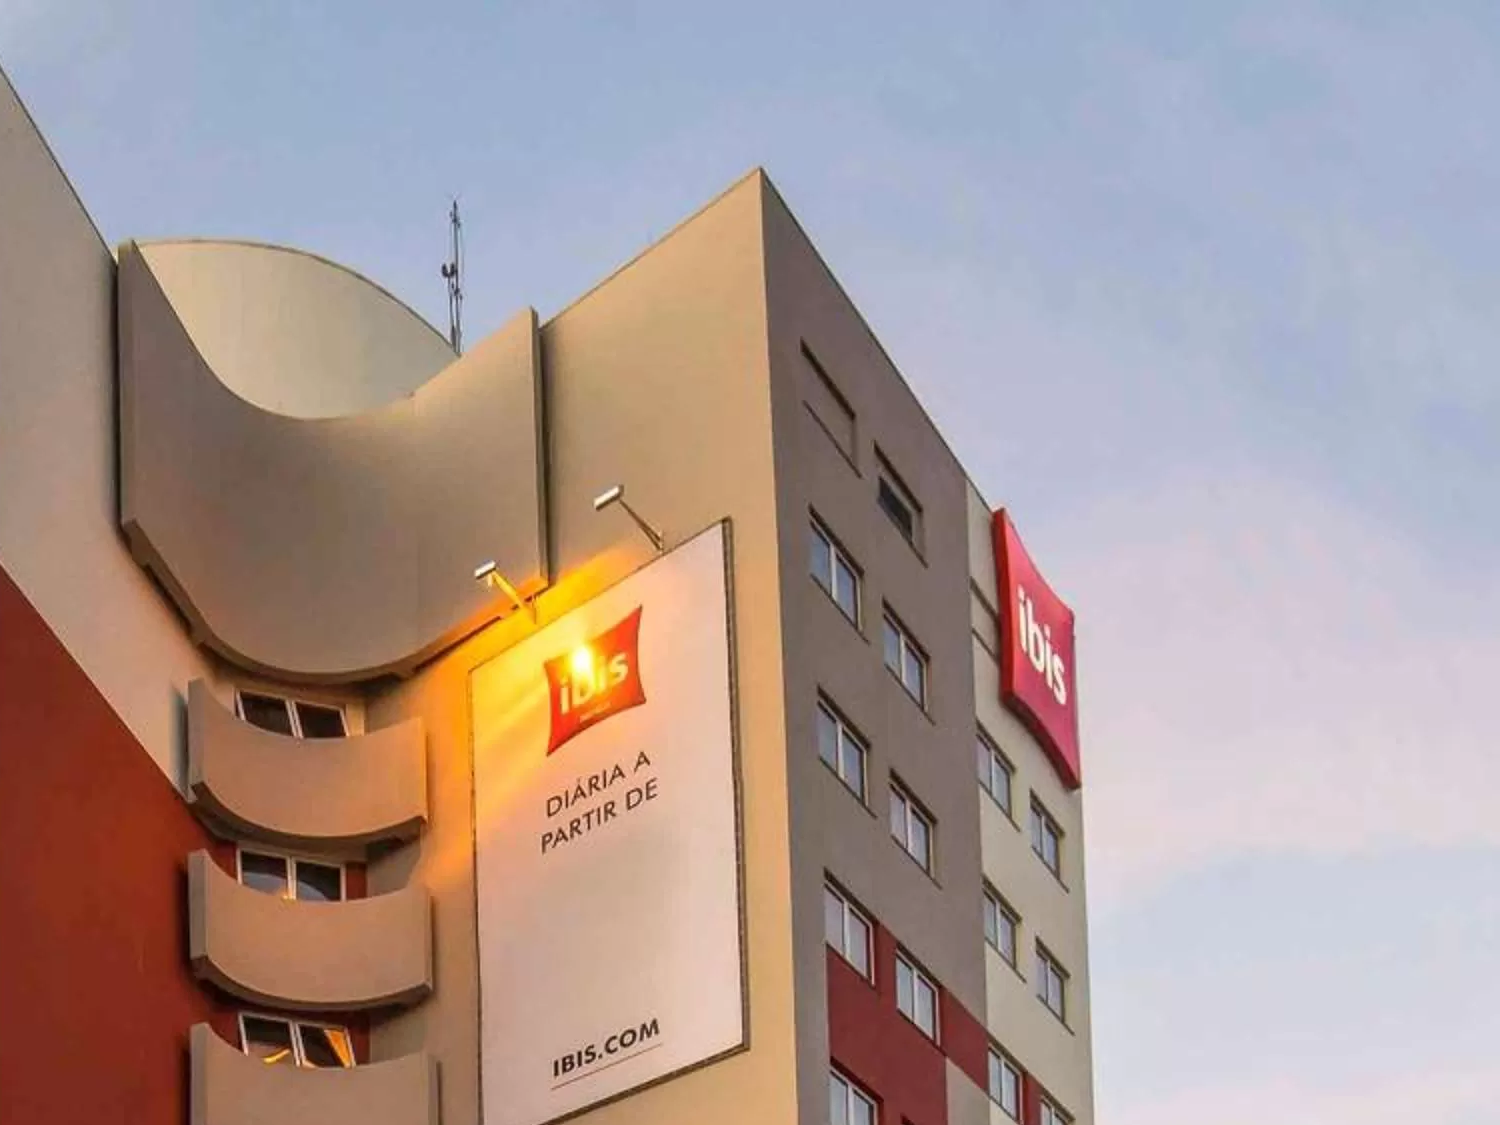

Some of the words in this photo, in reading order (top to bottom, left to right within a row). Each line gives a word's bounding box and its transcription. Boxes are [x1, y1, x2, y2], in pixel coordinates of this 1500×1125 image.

[1017, 583, 1067, 705] ibis
[541, 801, 617, 855] PARTIR
[626, 778, 659, 812] DE
[546, 764, 626, 818] DIÁRIA
[633, 751, 651, 773] A
[553, 1018, 660, 1077] IBIS.COM
